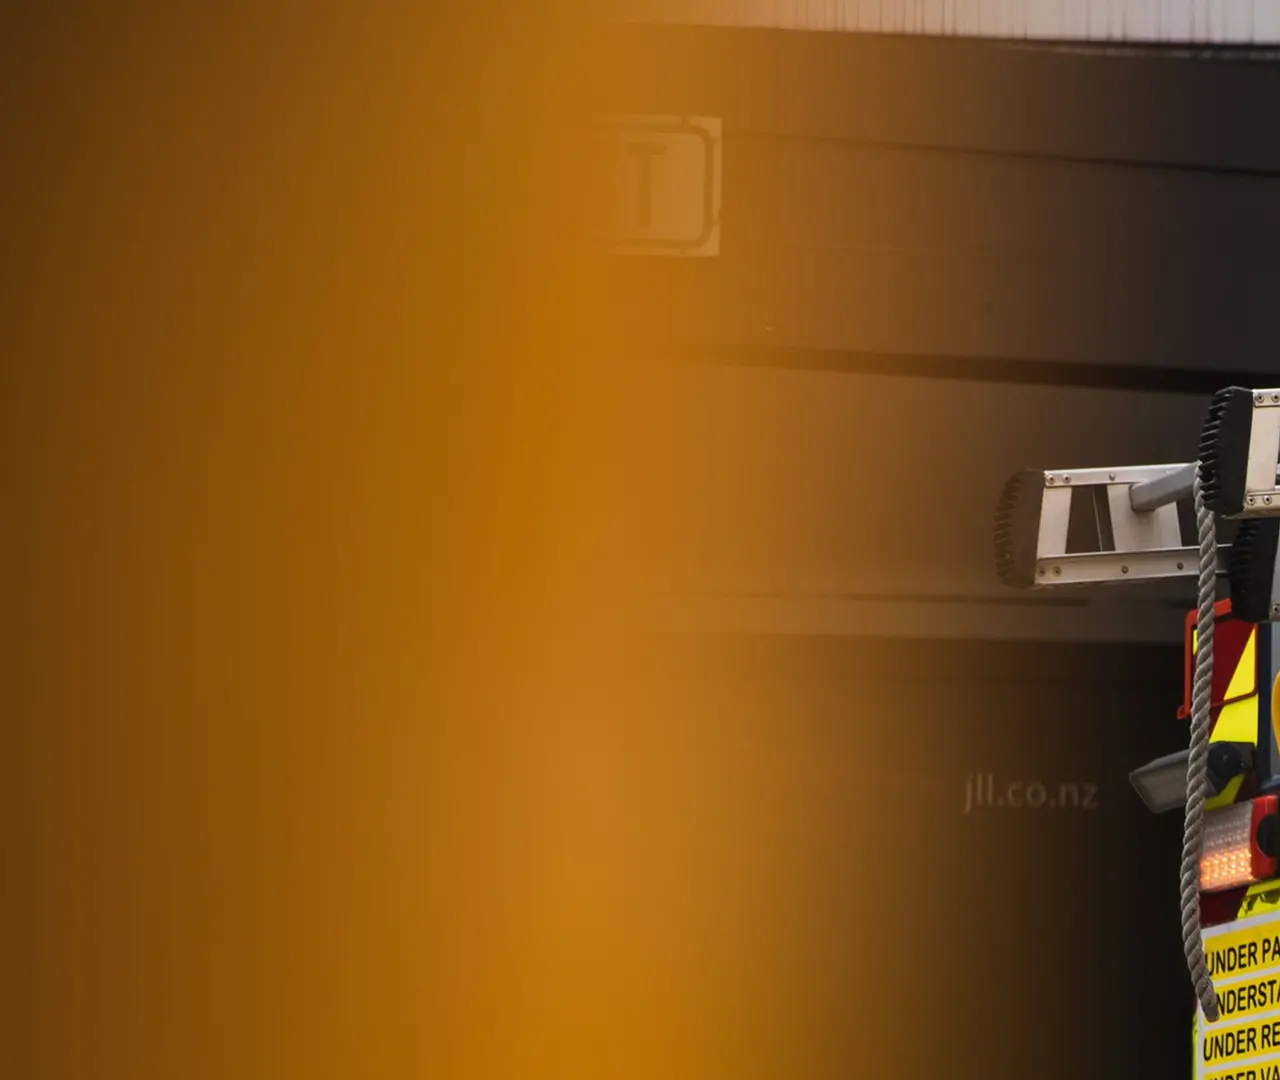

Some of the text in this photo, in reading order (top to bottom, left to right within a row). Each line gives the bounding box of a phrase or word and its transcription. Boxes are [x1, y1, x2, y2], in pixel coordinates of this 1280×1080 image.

[962, 772, 1099, 814] jll.co.nz
[1205, 941, 1257, 976] UNDER
[1203, 1026, 1257, 1062] UNDER
